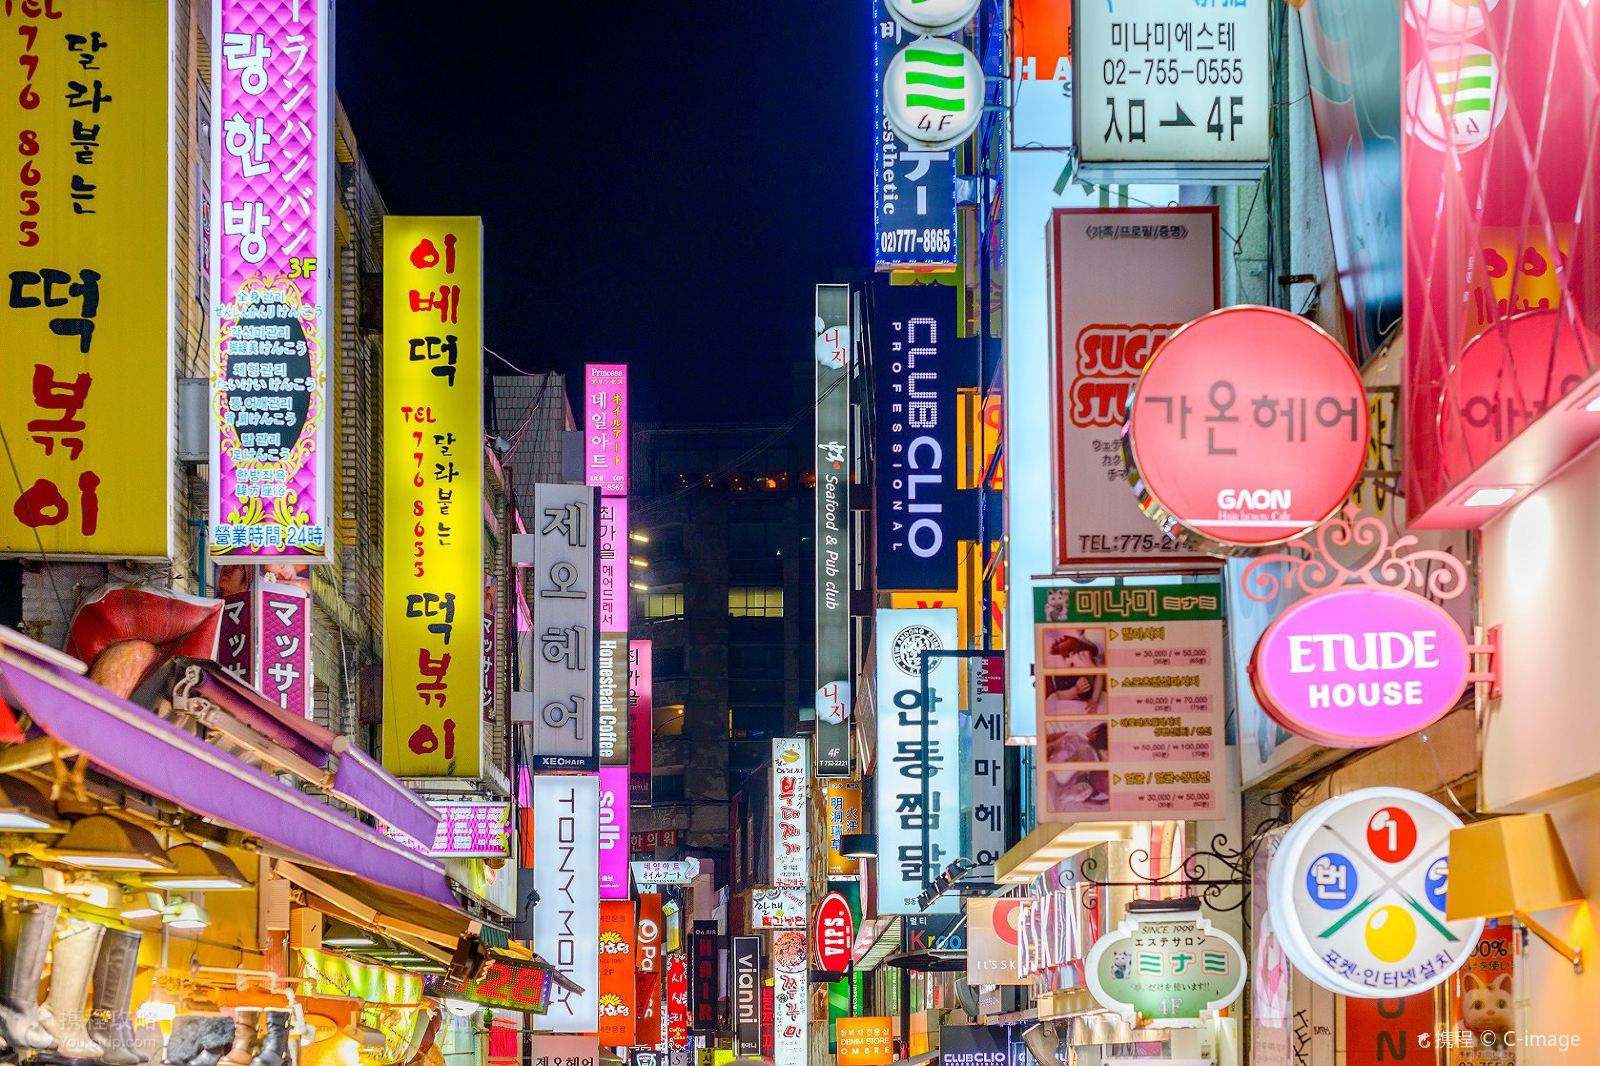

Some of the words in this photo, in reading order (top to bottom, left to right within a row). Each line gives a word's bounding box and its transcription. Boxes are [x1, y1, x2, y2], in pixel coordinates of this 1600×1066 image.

[1111, 22, 1236, 52] 미나미에스테
[1103, 58, 1244, 86] 02-755-0555
[917, 113, 954, 132] 4F
[1104, 97, 1146, 143] 入口
[1206, 96, 1245, 142] 4F
[882, 112, 899, 216] esthetic
[881, 228, 951, 253] 02)777-8865
[287, 258, 317, 280] 3F
[591, 367, 623, 377] Princess
[8, 268, 102, 537] 떡볶이
[400, 406, 437, 423] TEL
[590, 391, 609, 468] 네일아트
[1144, 379, 1358, 456] 가온헤어
[891, 321, 903, 552] PROFESSIONAL
[825, 474, 839, 532] Seafood
[1217, 488, 1292, 510] GAON
[825, 550, 839, 577] Pub
[825, 579, 839, 610] club
[1075, 589, 1158, 618] 미나미
[1287, 630, 1439, 673] ETUDE
[406, 592, 457, 760] 떡볶이
[1308, 681, 1424, 709] HOUSE
[828, 748, 841, 757] 4F
[1135, 937, 1207, 947] エステサロン
[738, 954, 758, 1023] vianni
